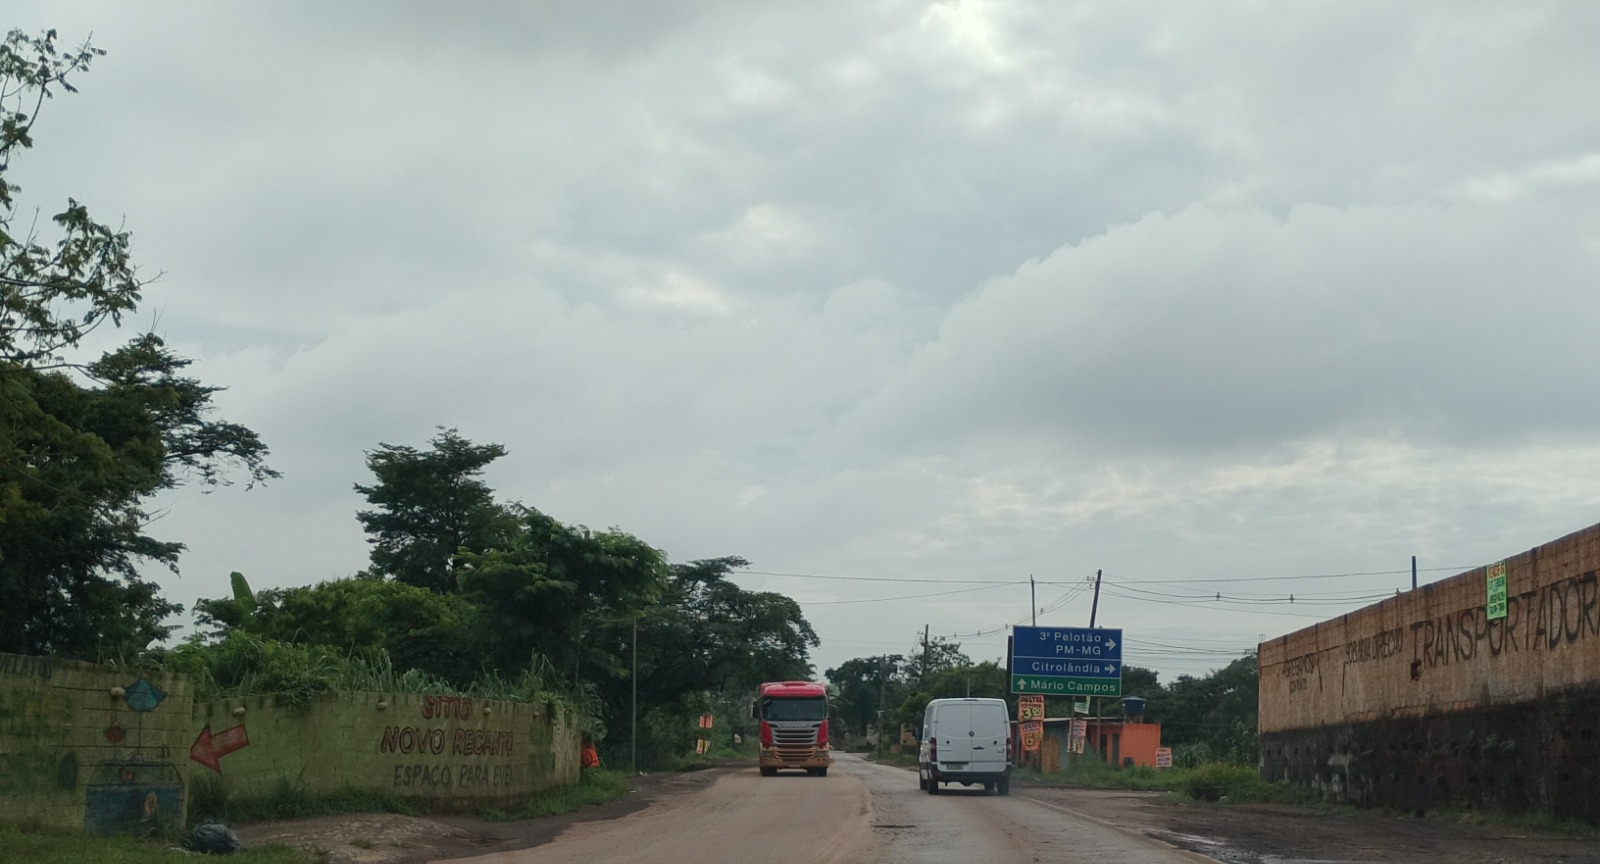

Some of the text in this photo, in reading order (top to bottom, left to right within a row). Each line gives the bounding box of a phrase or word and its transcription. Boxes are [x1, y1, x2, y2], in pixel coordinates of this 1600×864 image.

[1054, 631, 1101, 642] Pelotão
[1056, 645, 1101, 655] PM-MG
[1032, 661, 1100, 673] Citrolândia
[1030, 679, 1116, 693] Mário Campos
[380, 725, 514, 757] NOVO RECANTO
[393, 763, 451, 791] ESPAÇO
[459, 764, 489, 787] PARA
